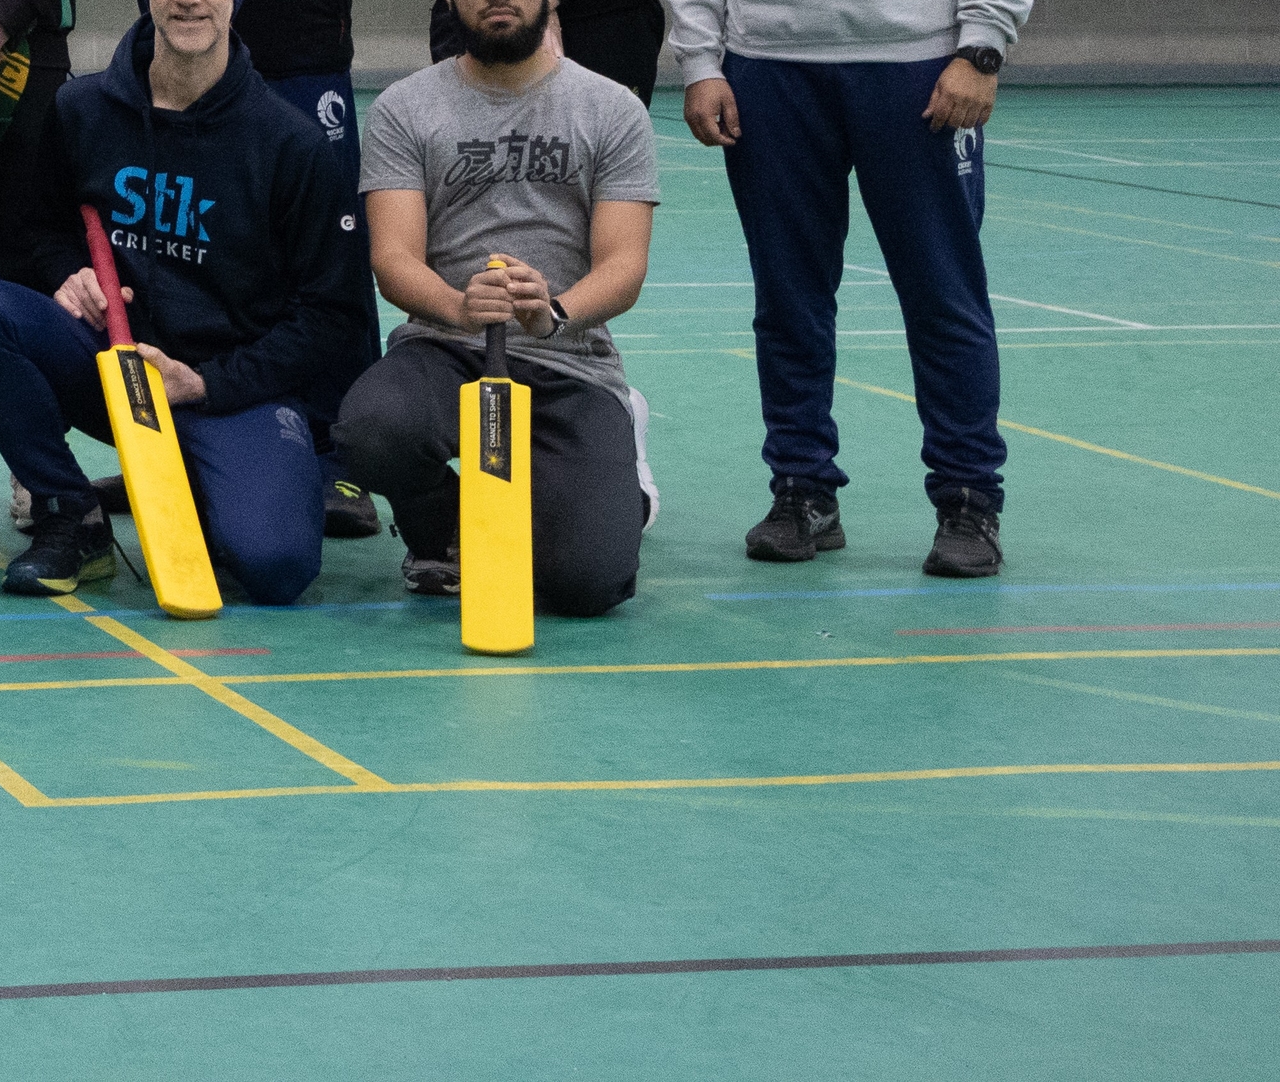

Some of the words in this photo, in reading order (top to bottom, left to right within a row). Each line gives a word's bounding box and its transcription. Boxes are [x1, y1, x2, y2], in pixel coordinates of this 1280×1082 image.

[111, 166, 216, 242] Stk
[111, 229, 207, 264] CRICKET
[126, 358, 136, 375] SHINE
[132, 382, 143, 405] CHANCE
[489, 412, 496, 421] TO
